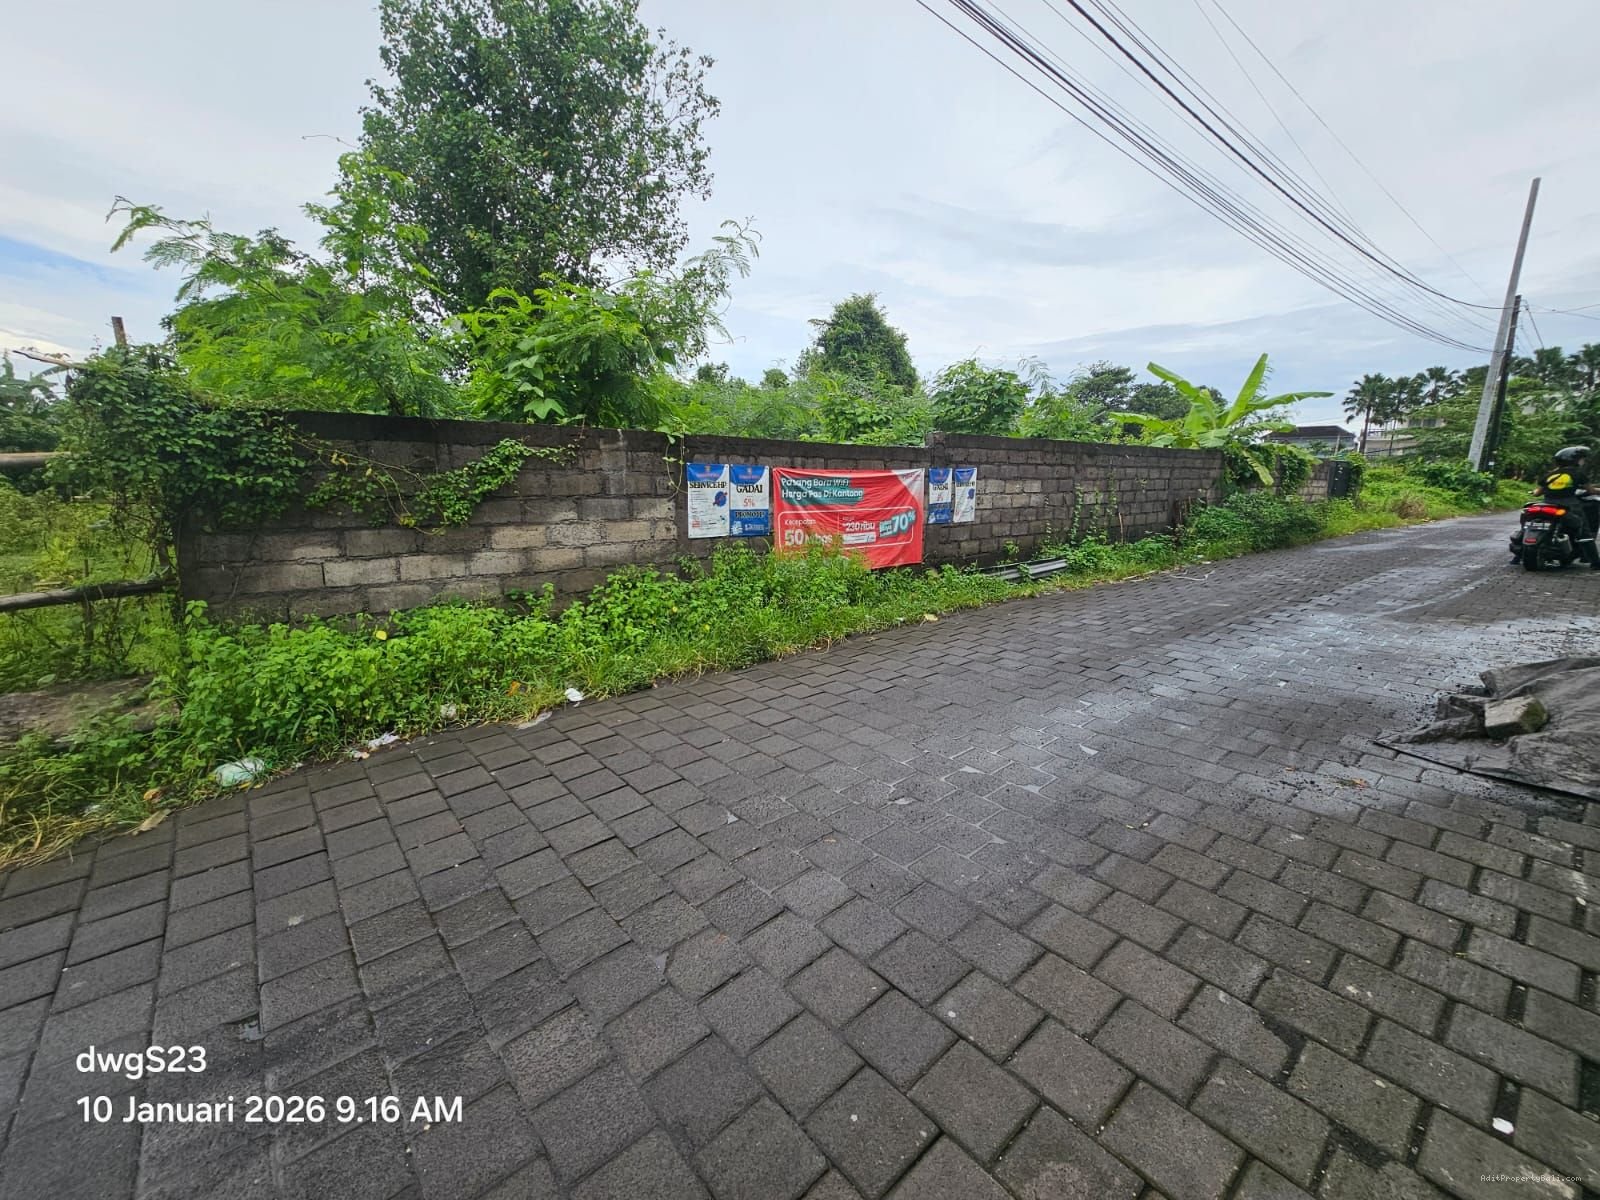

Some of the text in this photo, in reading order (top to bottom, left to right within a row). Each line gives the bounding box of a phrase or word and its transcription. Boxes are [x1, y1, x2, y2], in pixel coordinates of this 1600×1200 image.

[736, 484, 763, 494] GADAI
[781, 477, 813, 489] Pasang
[813, 478, 832, 487] Baru
[782, 489, 808, 500] Harga
[832, 489, 864, 500] Kantong
[891, 510, 916, 533] 70%
[784, 529, 804, 546] 50
